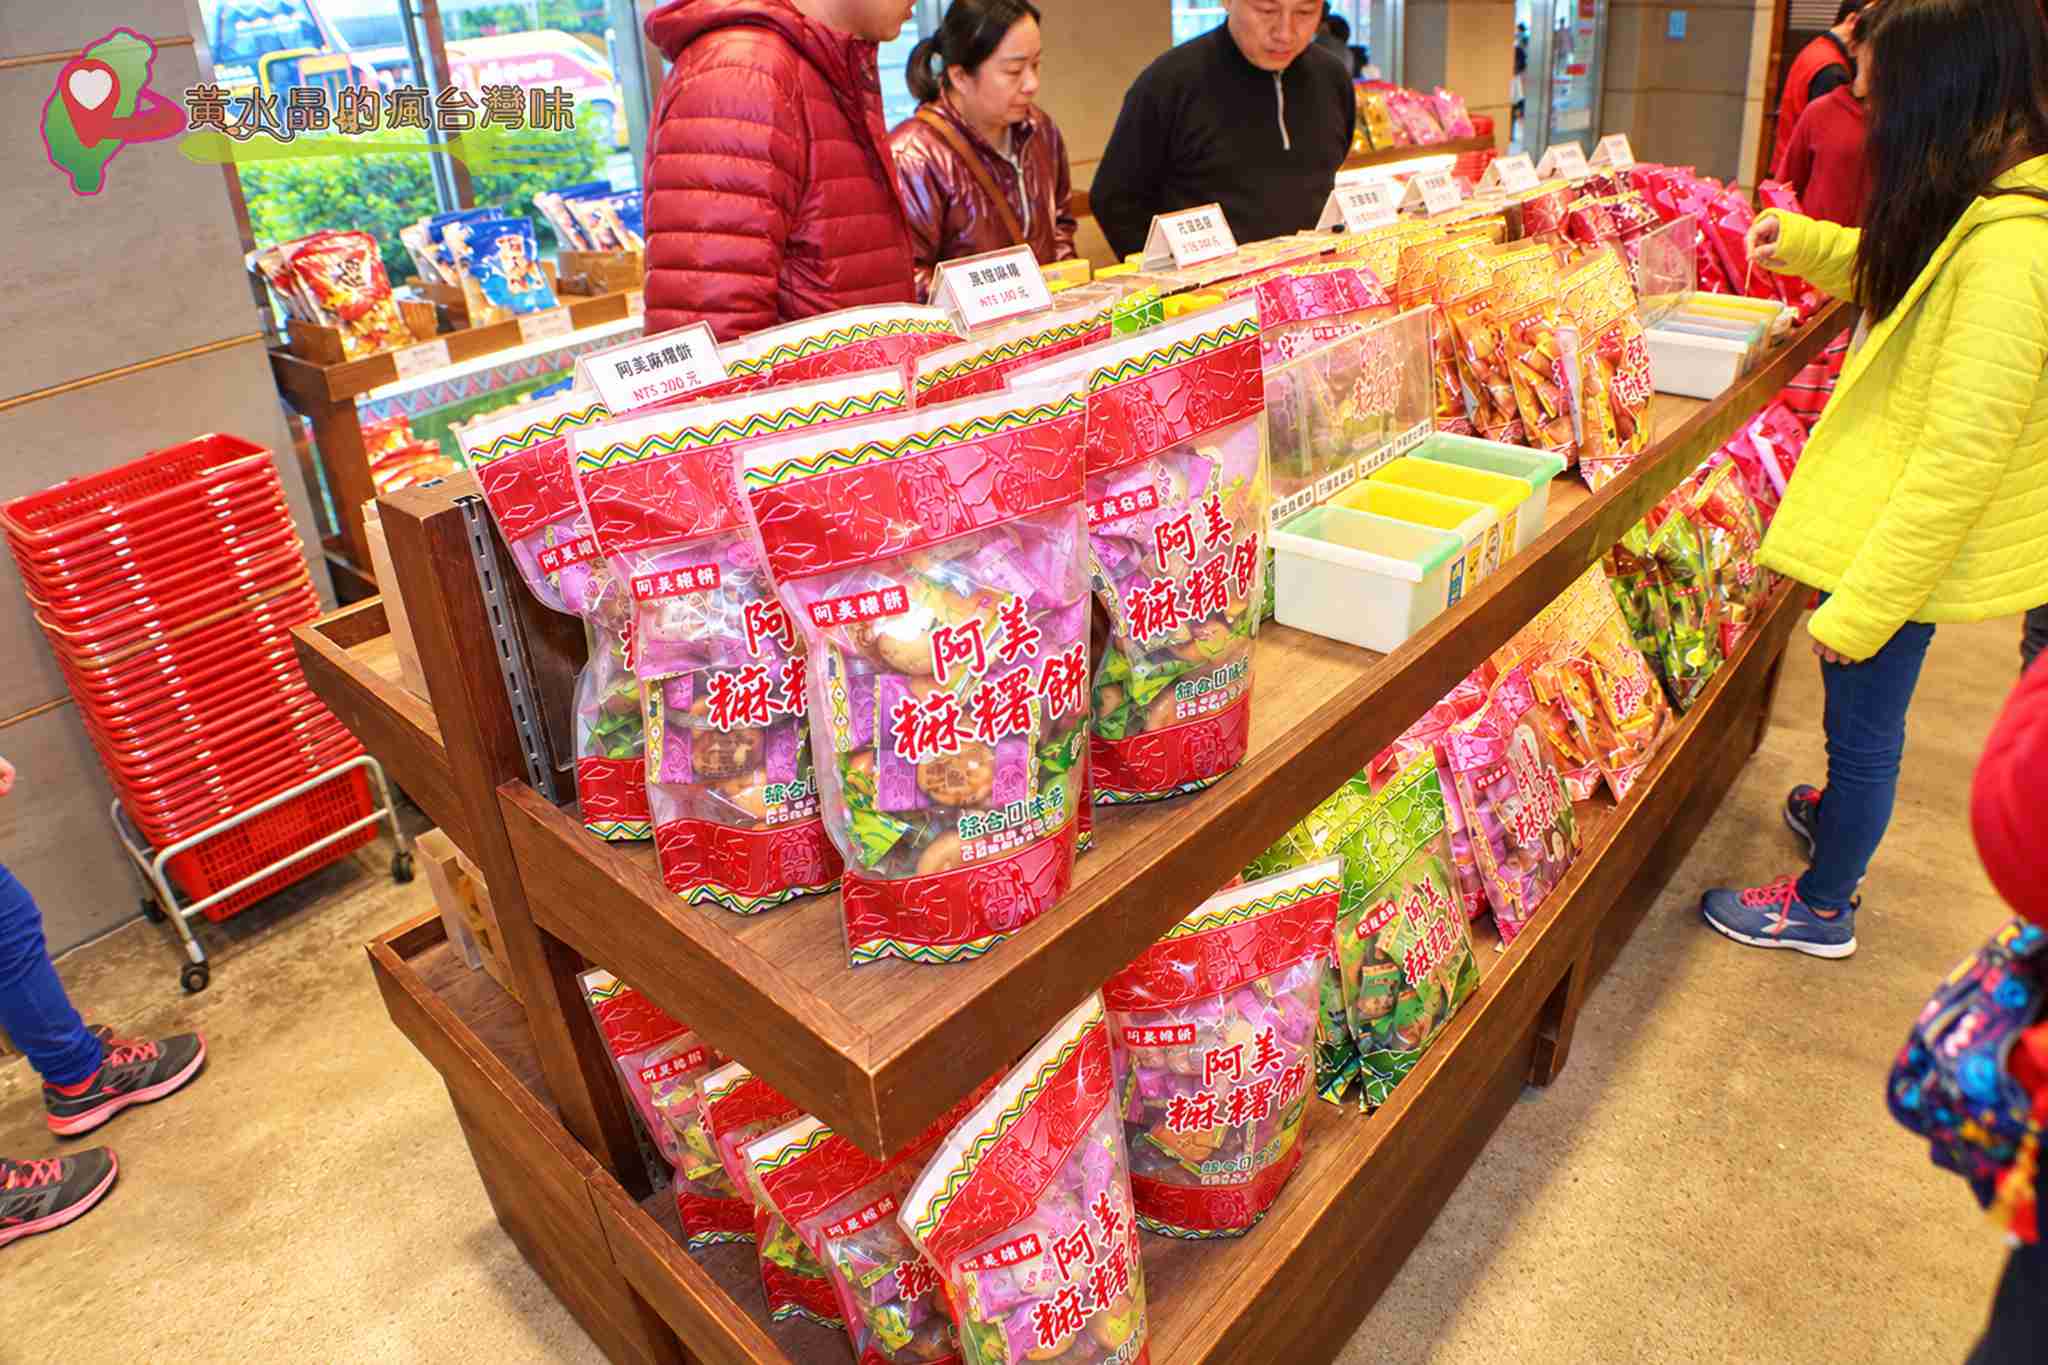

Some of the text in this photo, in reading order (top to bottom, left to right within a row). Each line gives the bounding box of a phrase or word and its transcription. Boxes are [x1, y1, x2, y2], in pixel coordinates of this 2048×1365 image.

[661, 376, 685, 393] 200
[685, 370, 702, 386] 元
[1155, 494, 1232, 570] 阿美
[931, 596, 1040, 682] 阿美
[1204, 1026, 1283, 1086] 阿美
[1053, 1192, 1124, 1281] 阿美
